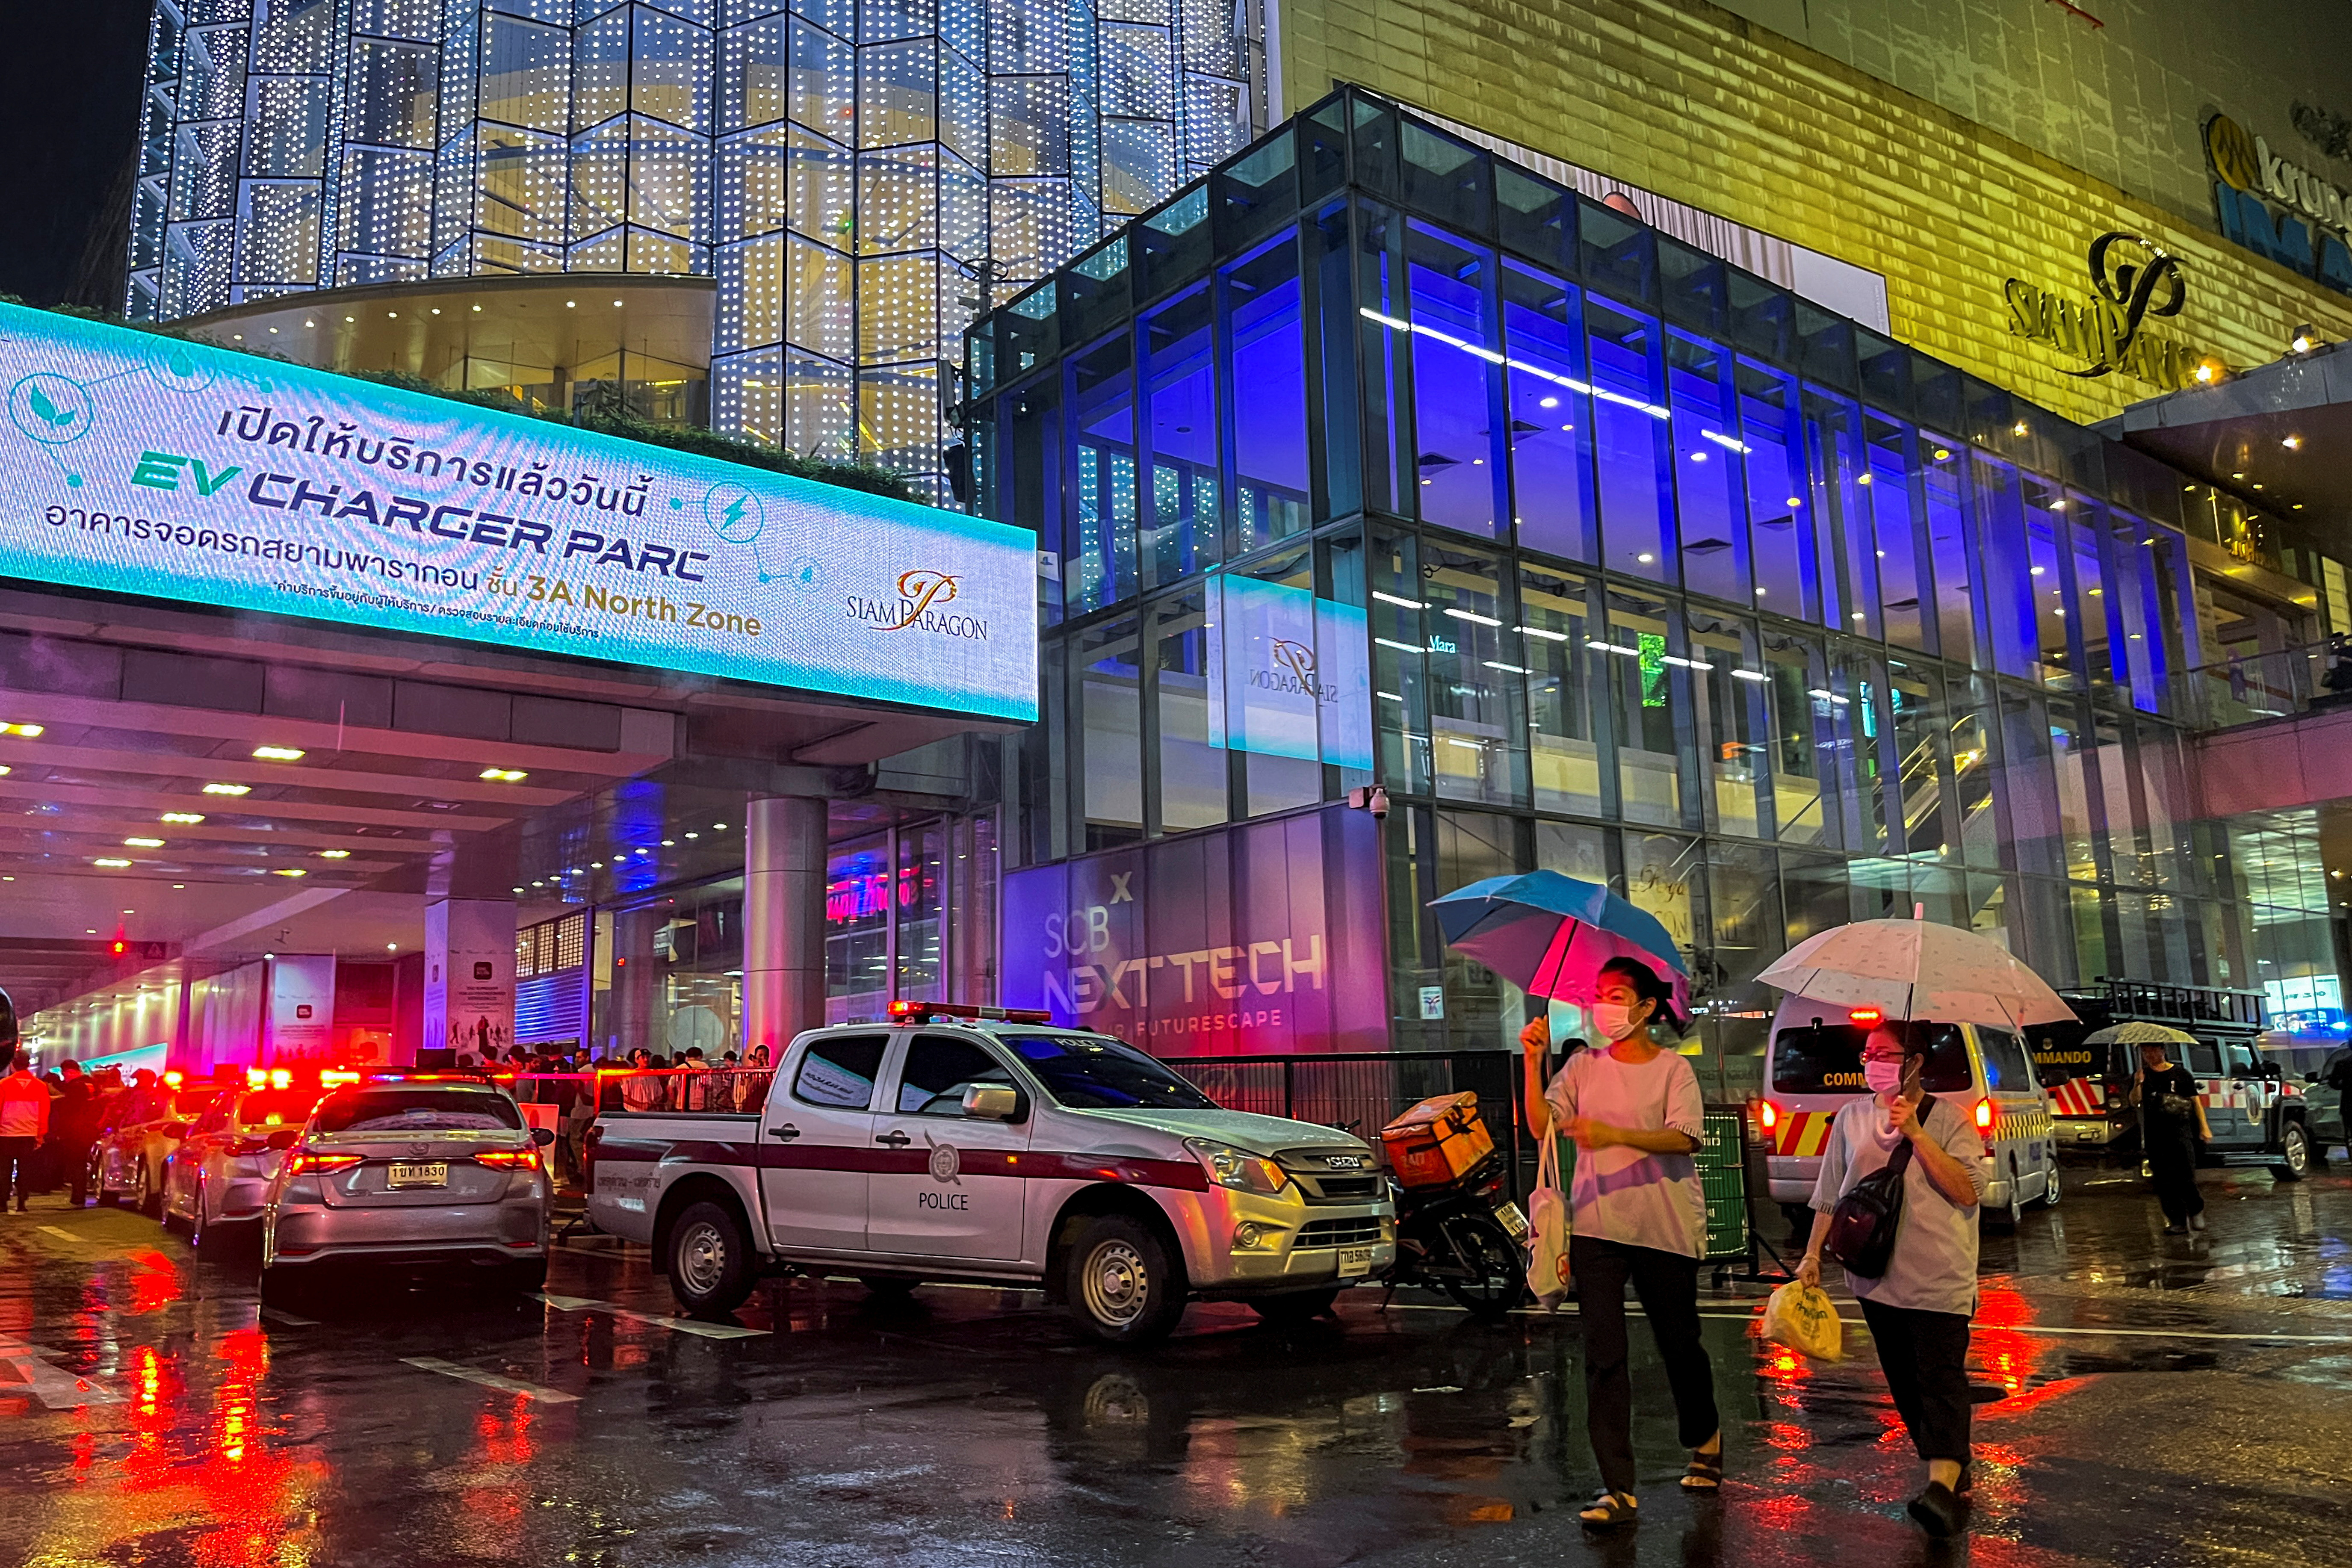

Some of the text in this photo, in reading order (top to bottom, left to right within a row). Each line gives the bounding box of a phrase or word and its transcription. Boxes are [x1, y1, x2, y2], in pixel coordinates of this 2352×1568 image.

[216, 404, 653, 517] เปิดให้บริการแล้ววันนี้
[130, 450, 711, 583] EV CHARGER PARC
[45, 504, 762, 638] อาคารจอดรถสยามพารากอน ชั้น 3A North Zone
[846, 595, 988, 641] SIAM PARAGON
[1043, 905, 1110, 959] SCB
[1043, 934, 1323, 1015] NEXT TECH
[1136, 1008, 1283, 1037] FUTURESCAPE
[1054, 1037, 1099, 1048] POLICE
[2032, 1051, 2092, 1064] MMANDO
[1823, 1072, 1866, 1086] COMM
[418, 1166, 445, 1176] 1830
[919, 1192, 969, 1211] POLICE
